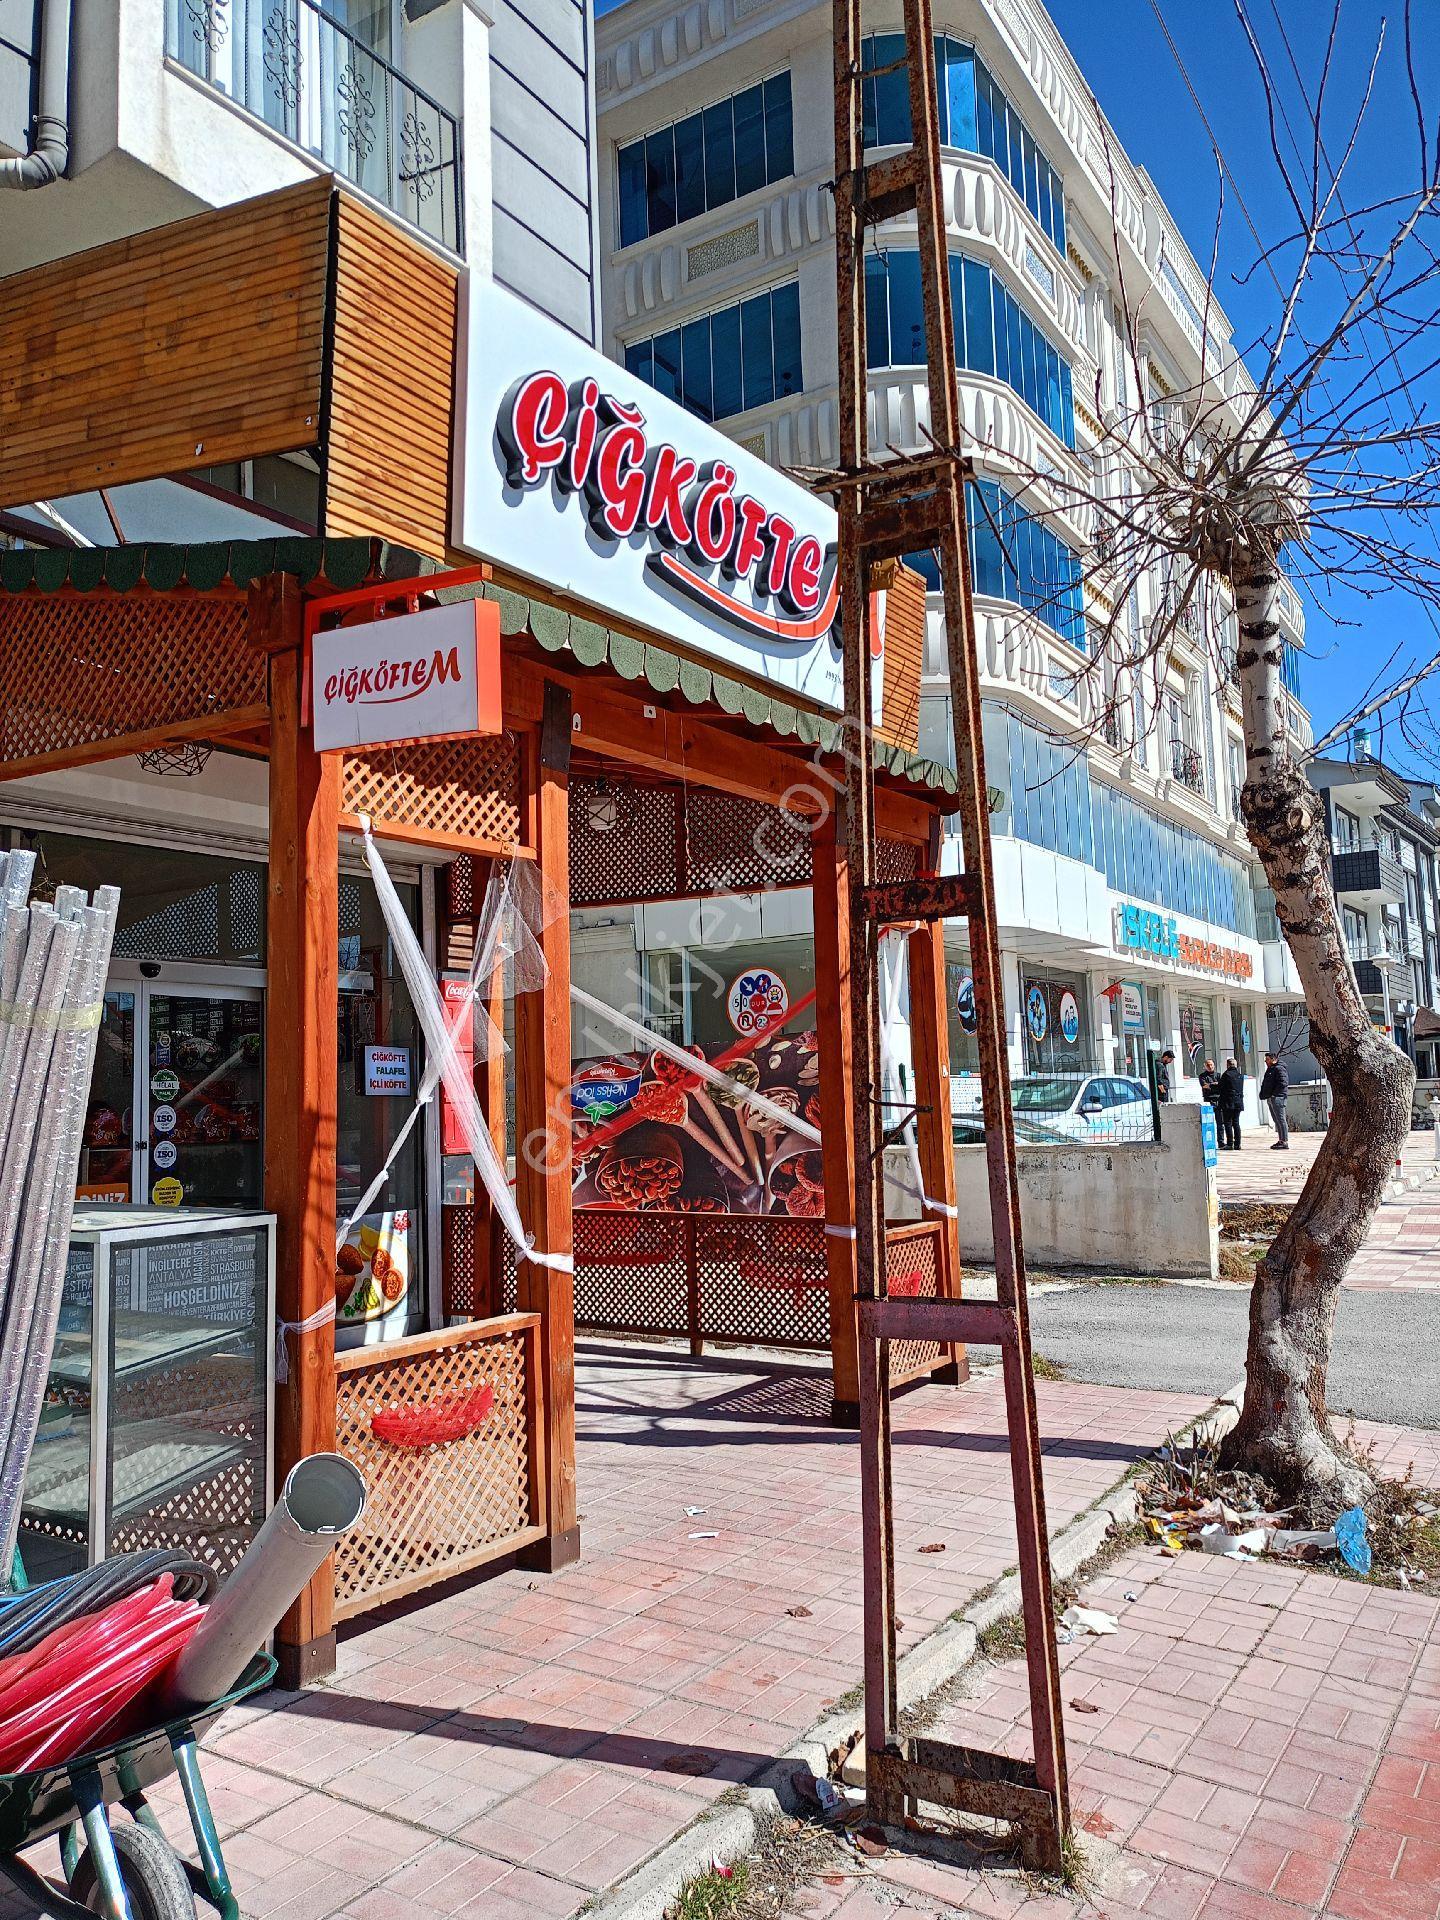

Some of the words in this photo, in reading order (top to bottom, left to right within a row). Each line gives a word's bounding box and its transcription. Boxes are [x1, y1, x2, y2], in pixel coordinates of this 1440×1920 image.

[324, 647, 461, 706] ÇİĞKÖFTEM
[371, 1051, 406, 1063] ÇİĞKÖFTE
[376, 1066, 406, 1076] FALAFEL
[369, 1078, 383, 1089] İÇLİ
[384, 1080, 407, 1089] KÖFTE
[156, 1114, 173, 1123] ISO
[157, 1150, 173, 1159] ISO
[148, 1256, 192, 1273] İNGİLTERE
[149, 1268, 193, 1284] ANTALYA
[163, 1281, 240, 1309] HOŞGELDİNİZ
